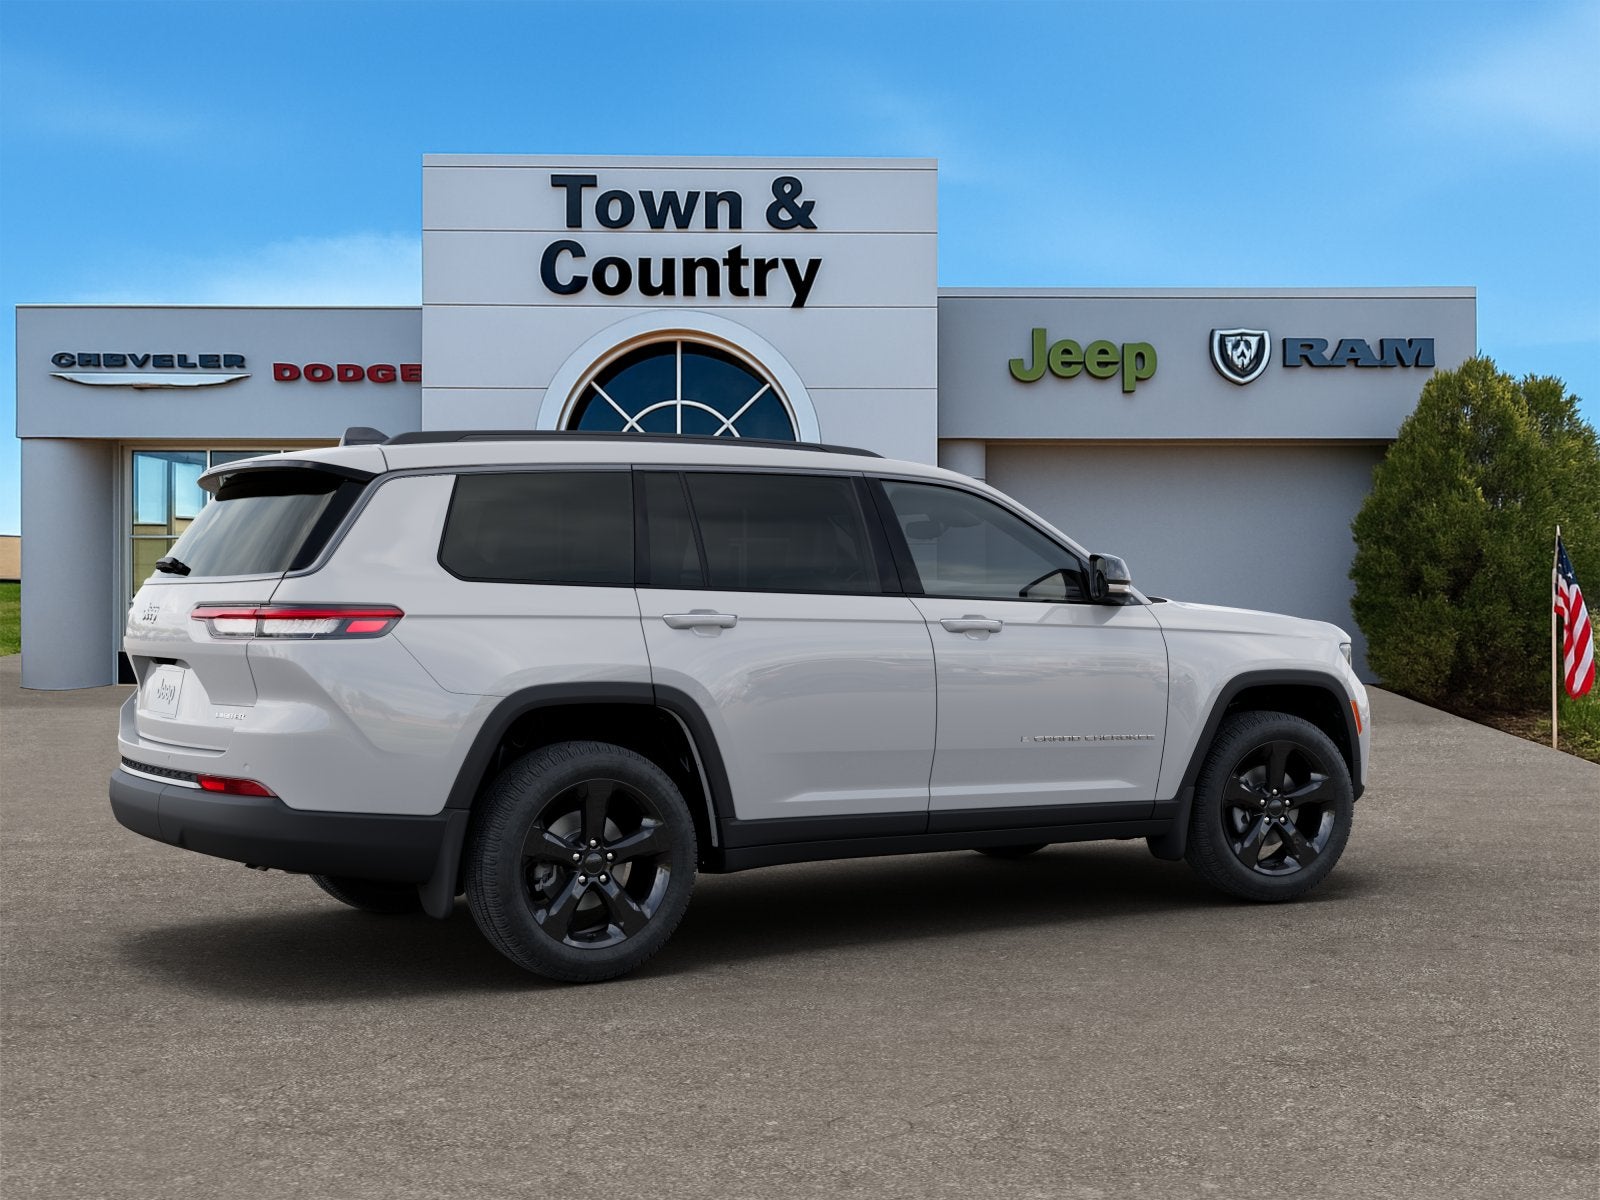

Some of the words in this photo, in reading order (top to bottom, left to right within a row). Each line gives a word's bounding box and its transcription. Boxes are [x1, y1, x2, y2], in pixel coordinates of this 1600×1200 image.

[550, 173, 743, 230] Town
[765, 175, 818, 230] &
[539, 239, 823, 308] Country
[273, 362, 422, 383] DODGE
[1009, 327, 1158, 394] Jeep
[1282, 337, 1436, 368] RAM
[1033, 735, 1082, 743] GRAND
[1084, 733, 1156, 742] CHEROKEE
